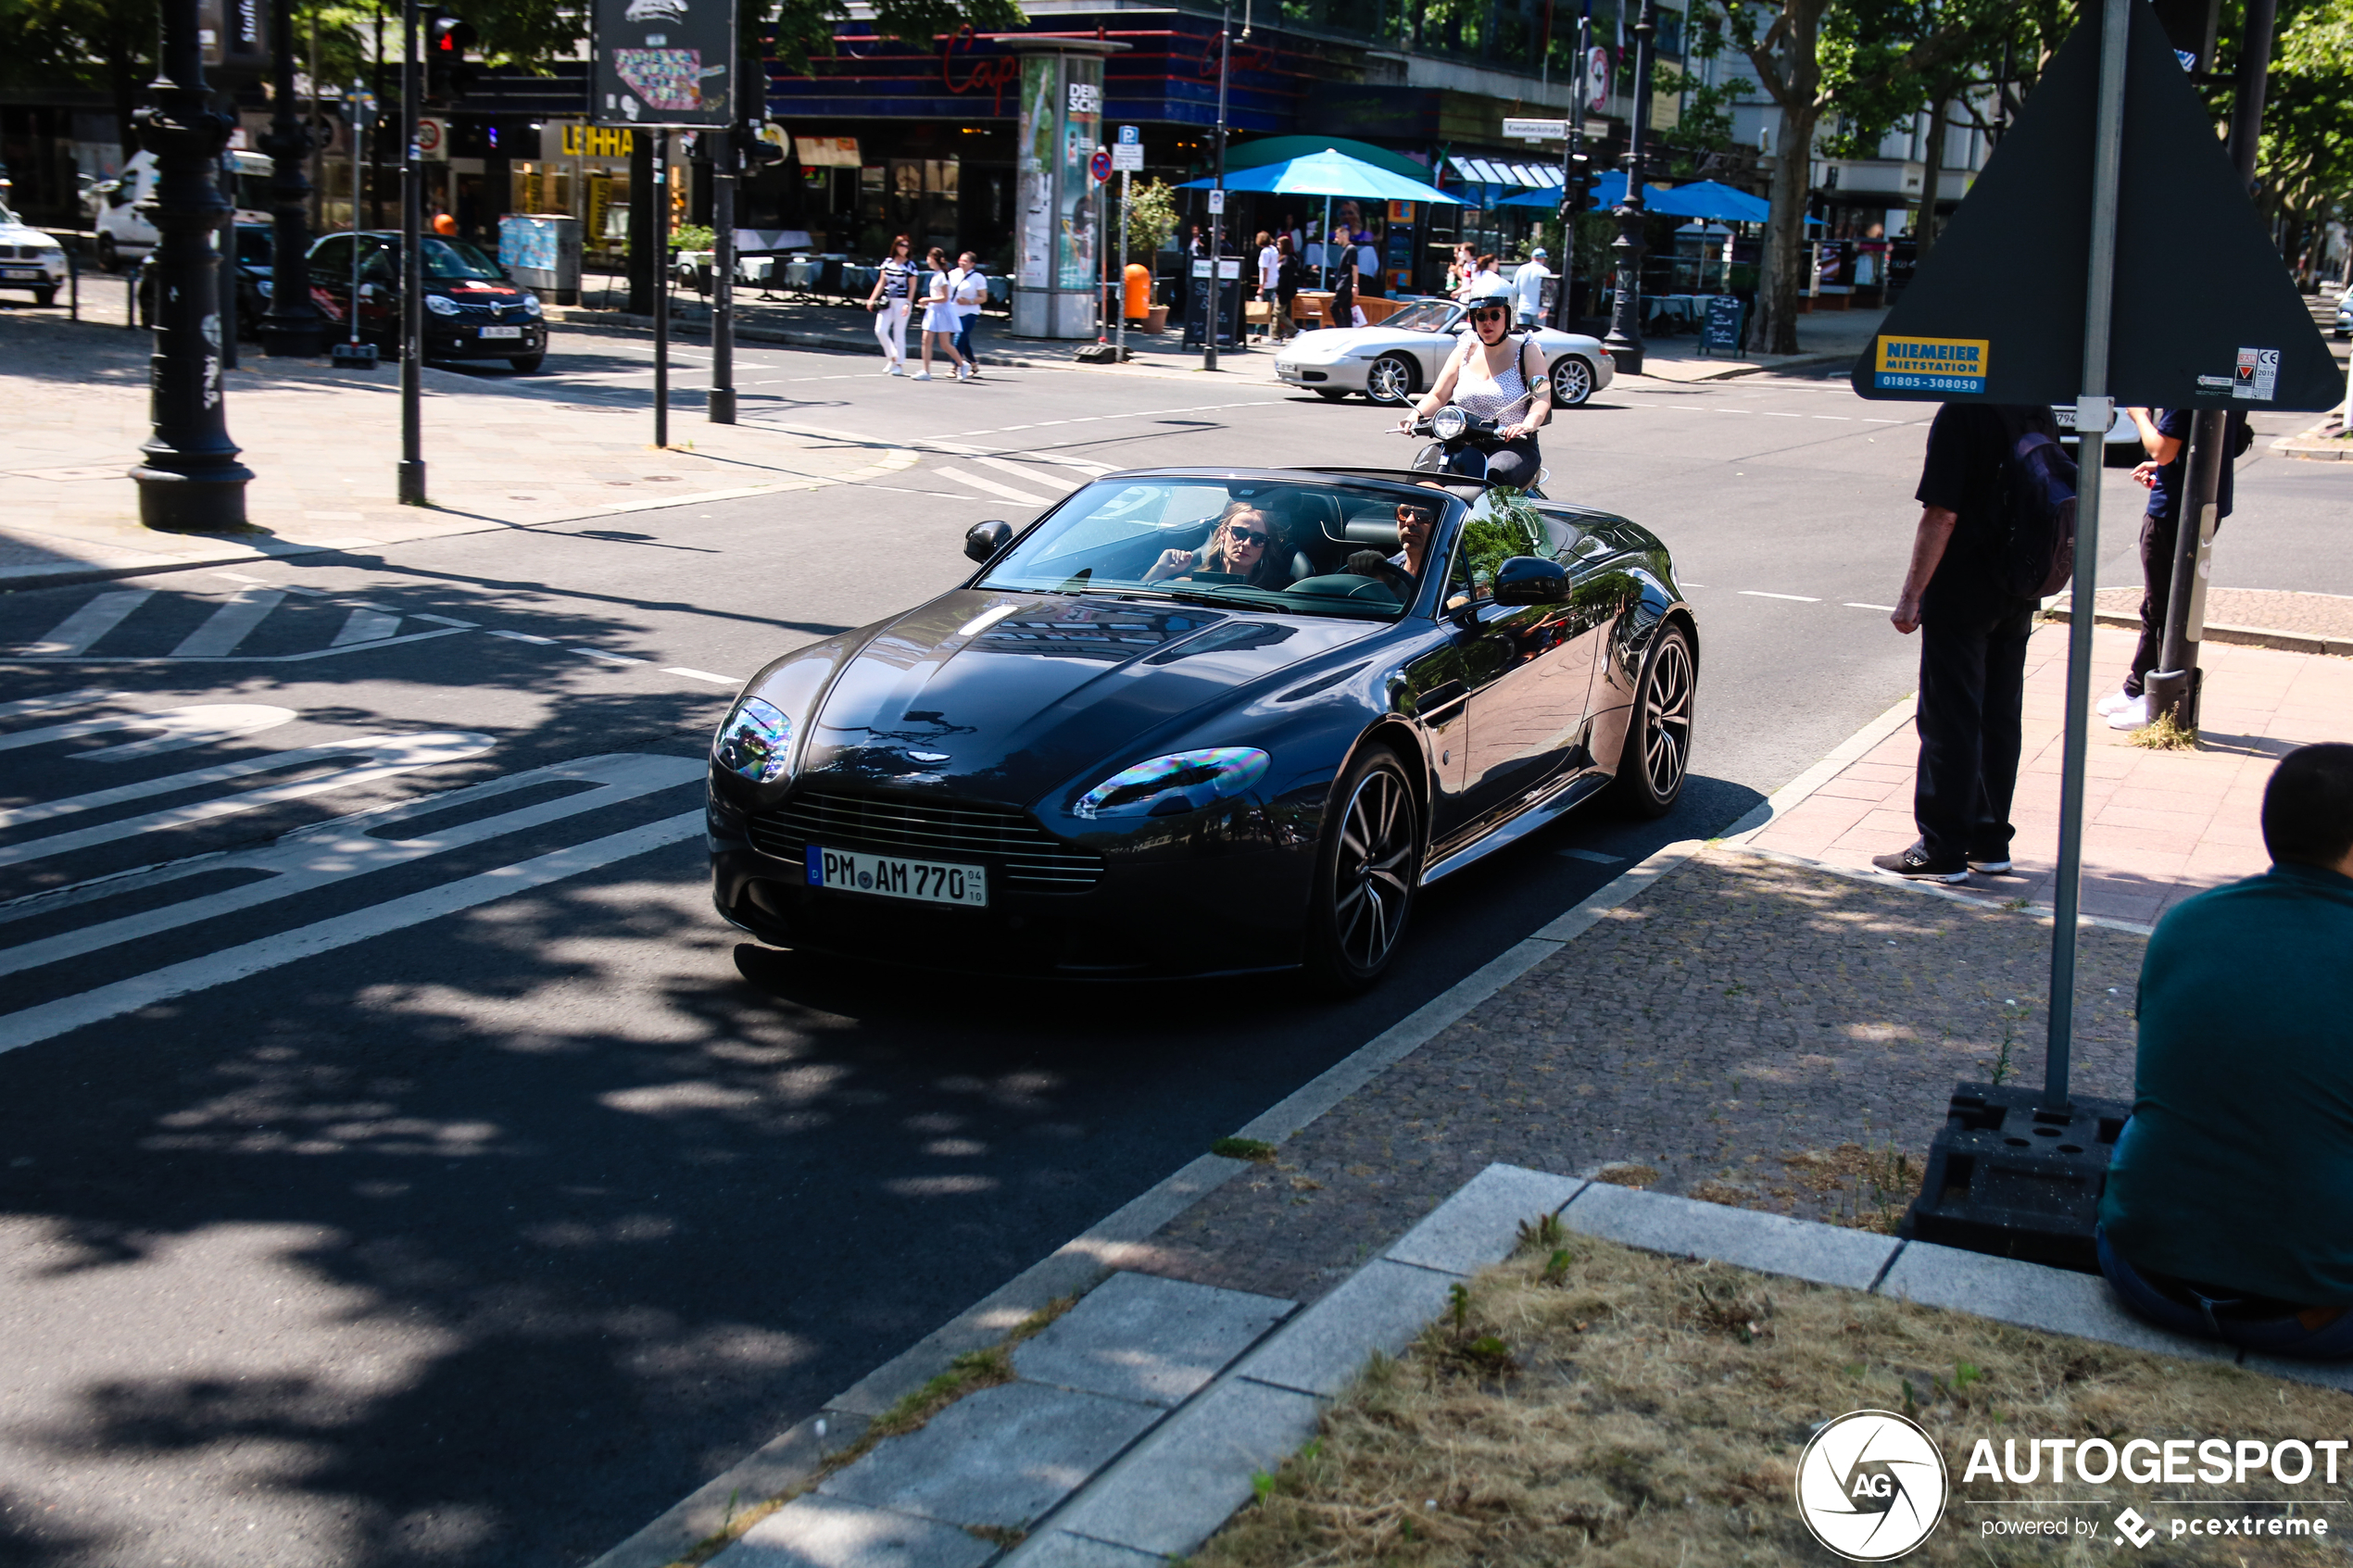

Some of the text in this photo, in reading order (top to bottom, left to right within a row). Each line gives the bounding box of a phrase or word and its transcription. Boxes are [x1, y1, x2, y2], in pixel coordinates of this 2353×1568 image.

[1886, 343, 1981, 362] NIEMEIER
[2259, 351, 2278, 364] CE
[1885, 360, 1978, 372] MIETSTATION
[2057, 414, 2076, 422] 794
[824, 852, 964, 899] PM AM 770
[968, 870, 982, 881] 04
[970, 891, 982, 902] 10
